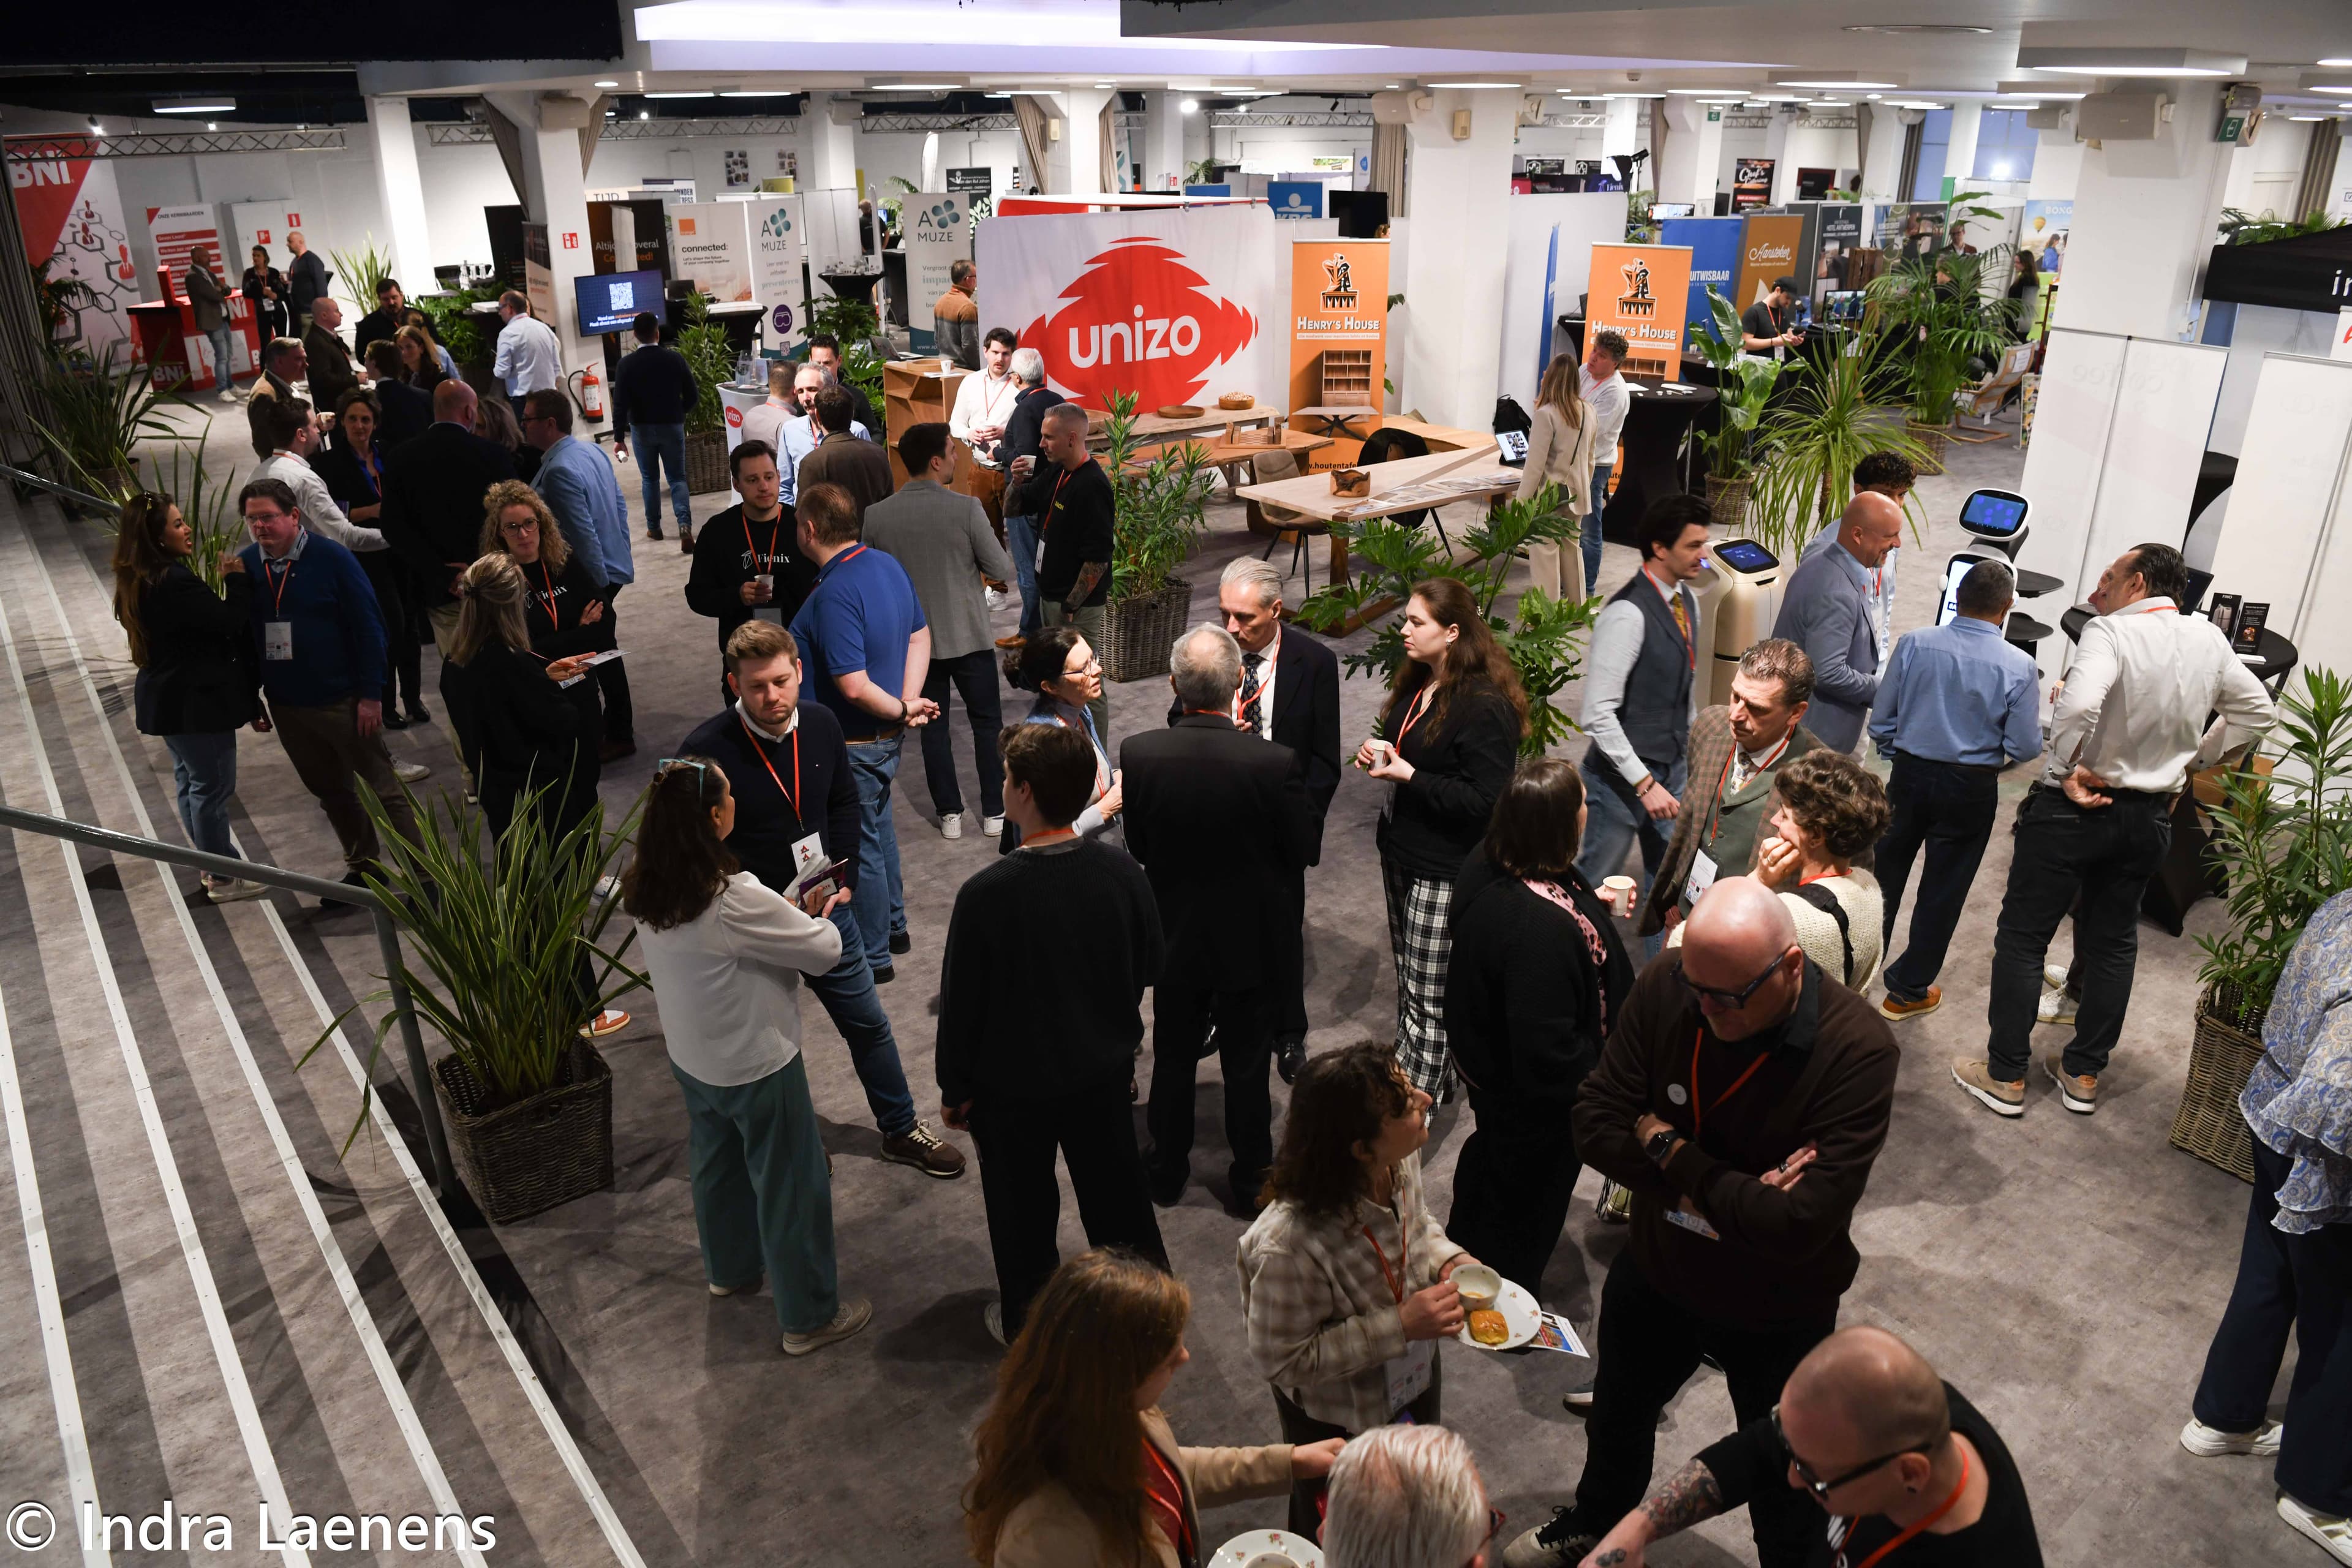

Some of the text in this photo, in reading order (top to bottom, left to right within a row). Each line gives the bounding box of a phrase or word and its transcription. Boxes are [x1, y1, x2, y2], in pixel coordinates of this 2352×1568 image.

[7, 149, 70, 188] BNI
[2045, 206, 2073, 214] BONG
[918, 211, 933, 227] A
[761, 220, 772, 237] A
[918, 232, 954, 242] MUZE
[761, 240, 787, 252] MUZE
[922, 275, 951, 286] impac
[226, 296, 247, 320] NI
[1297, 316, 1380, 330] HENRY'S HOUSE
[1069, 304, 1200, 368] unizo
[1640, 324, 1676, 340] HOUSE
[726, 410, 741, 423] unizo
[539, 586, 567, 600] ienix
